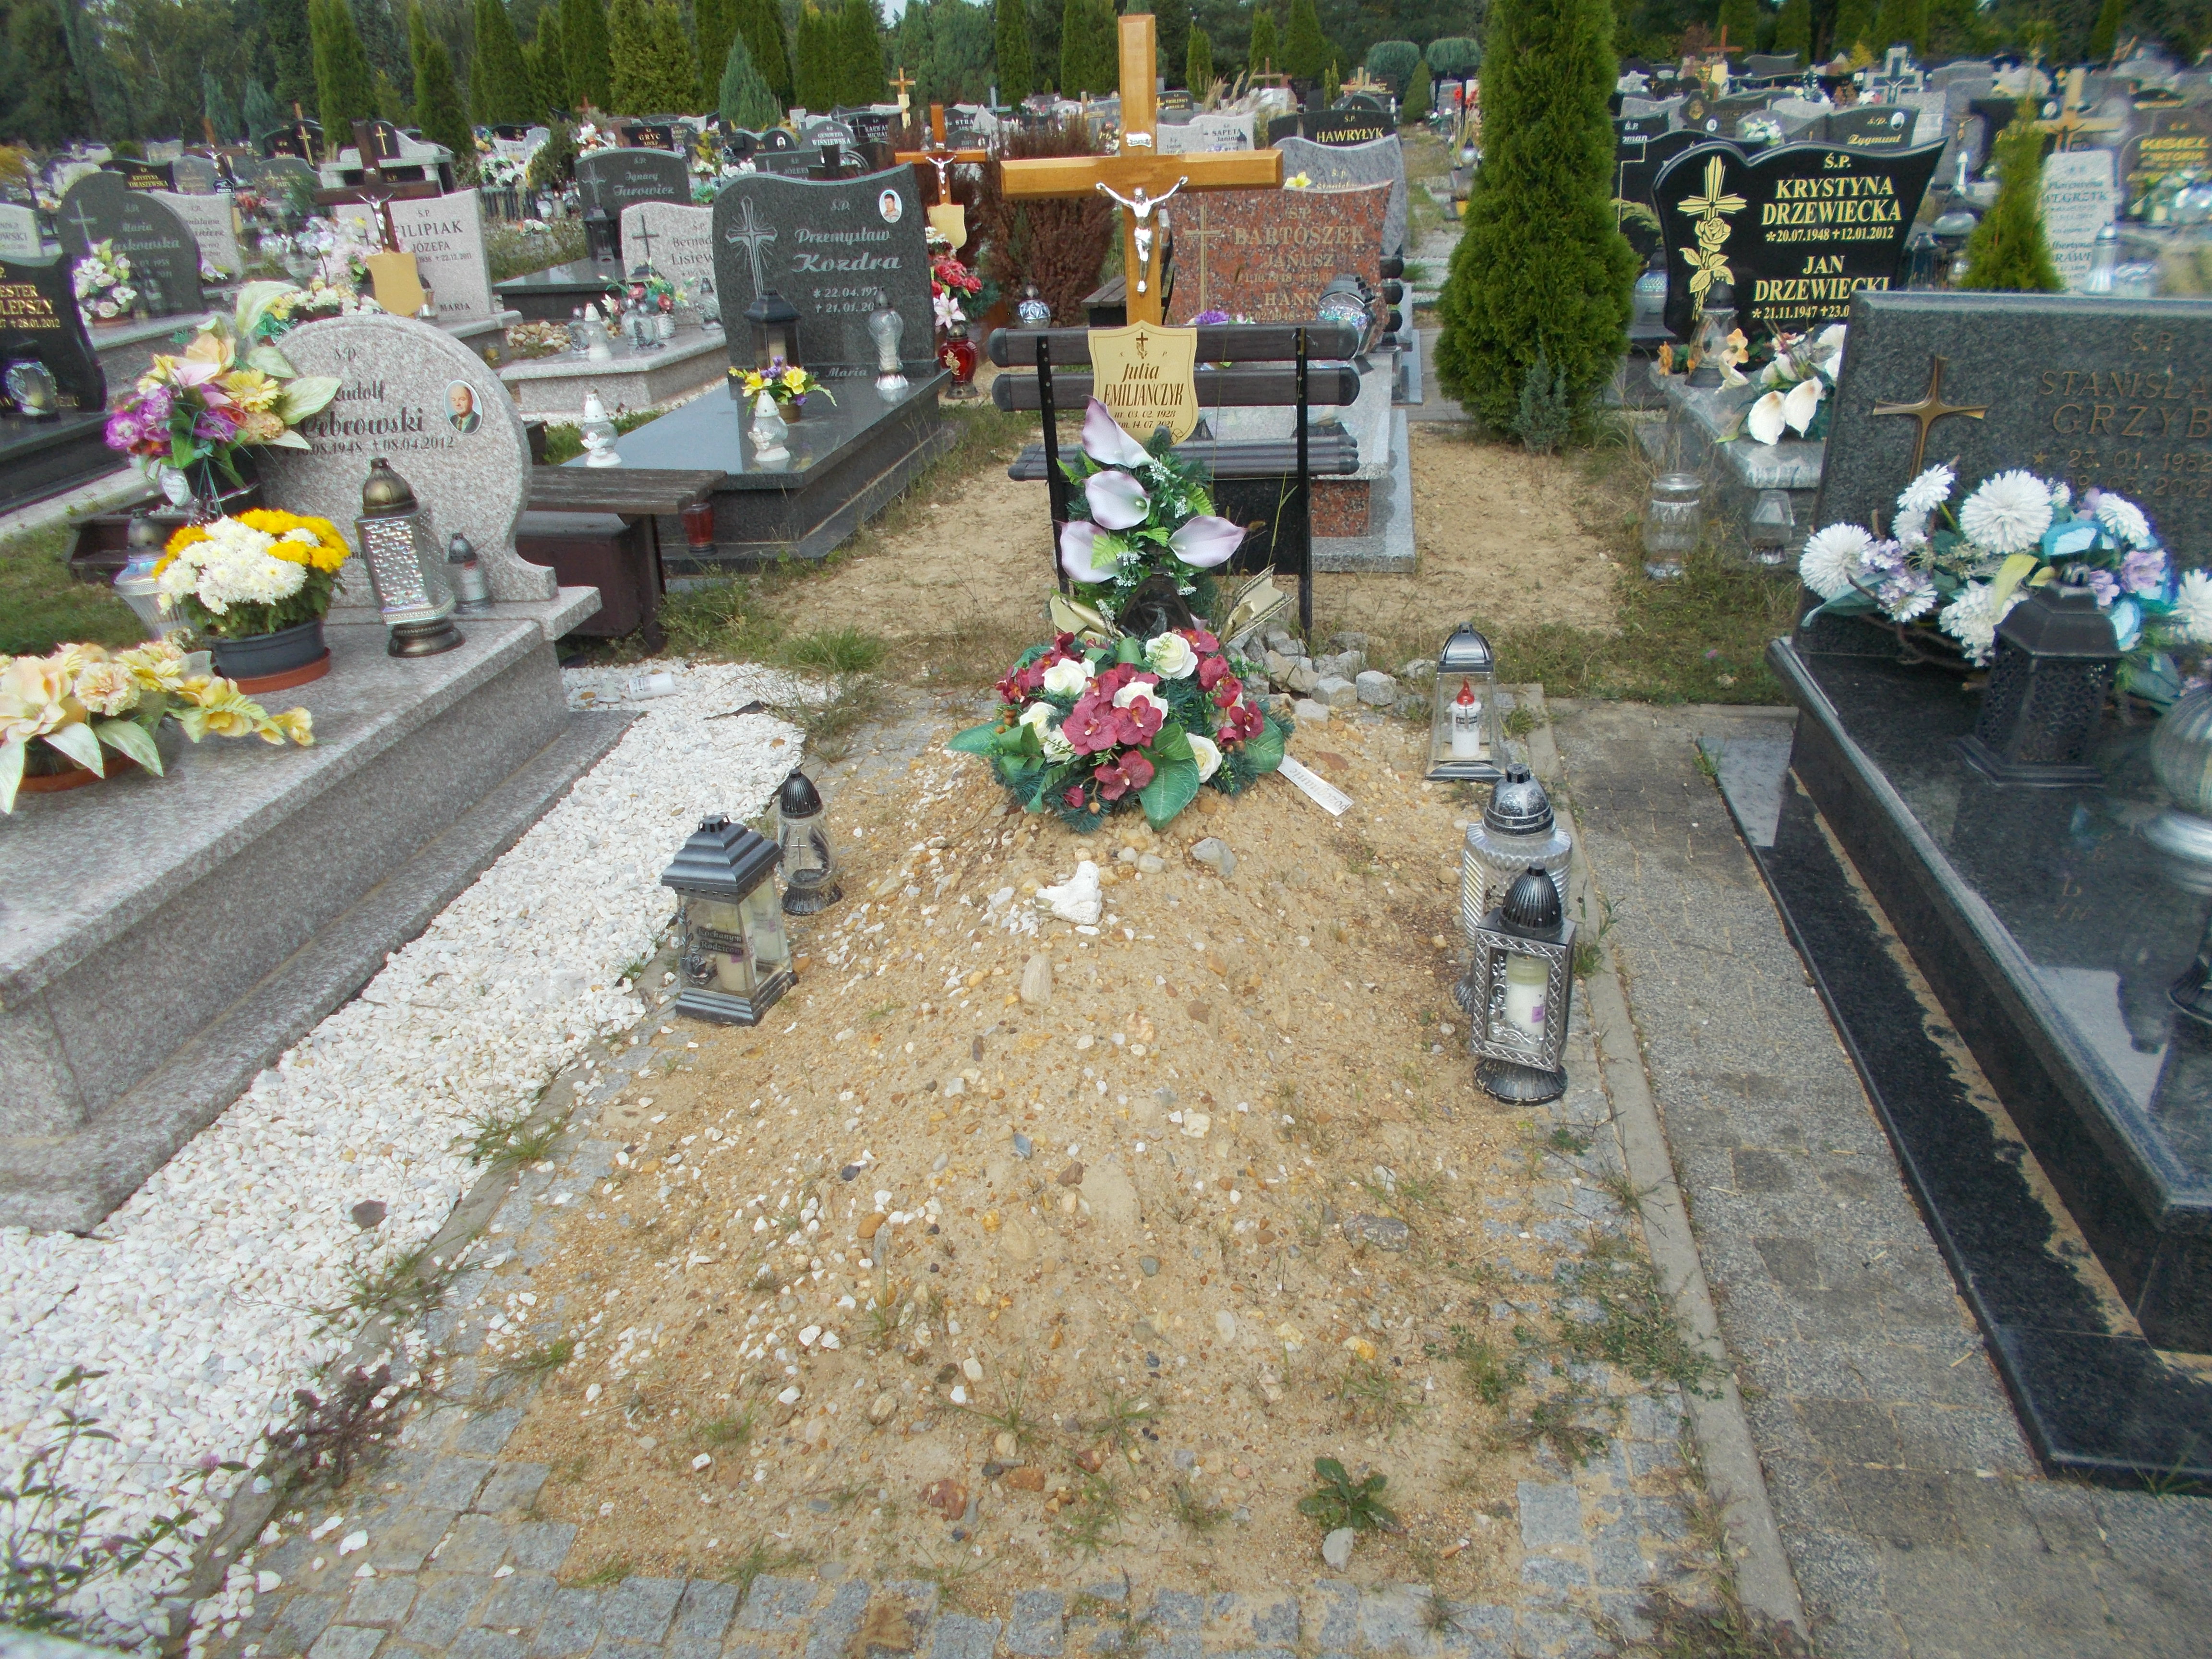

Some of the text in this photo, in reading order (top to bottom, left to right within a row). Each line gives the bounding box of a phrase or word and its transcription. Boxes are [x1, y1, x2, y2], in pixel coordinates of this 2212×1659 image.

[1317, 127, 1384, 143] HAWRYŁYK
[1775, 176, 1894, 199] KRYSTYNA
[1761, 199, 1902, 225] DRZEWIECKA
[795, 227, 890, 245] Przemysław
[1234, 226, 1365, 245] BARTOSZEK
[791, 252, 902, 272] Kozdra
[1266, 254, 1334, 267] JANUSZ
[1803, 255, 1845, 274] JAN
[1754, 277, 1891, 301] DRZEWIECKI
[439, 303, 471, 312] MARIA
[1264, 293, 1320, 306] HANN
[826, 367, 868, 377] Maria
[1122, 363, 1159, 383] Julia
[2053, 404, 2212, 438] GRZYB
